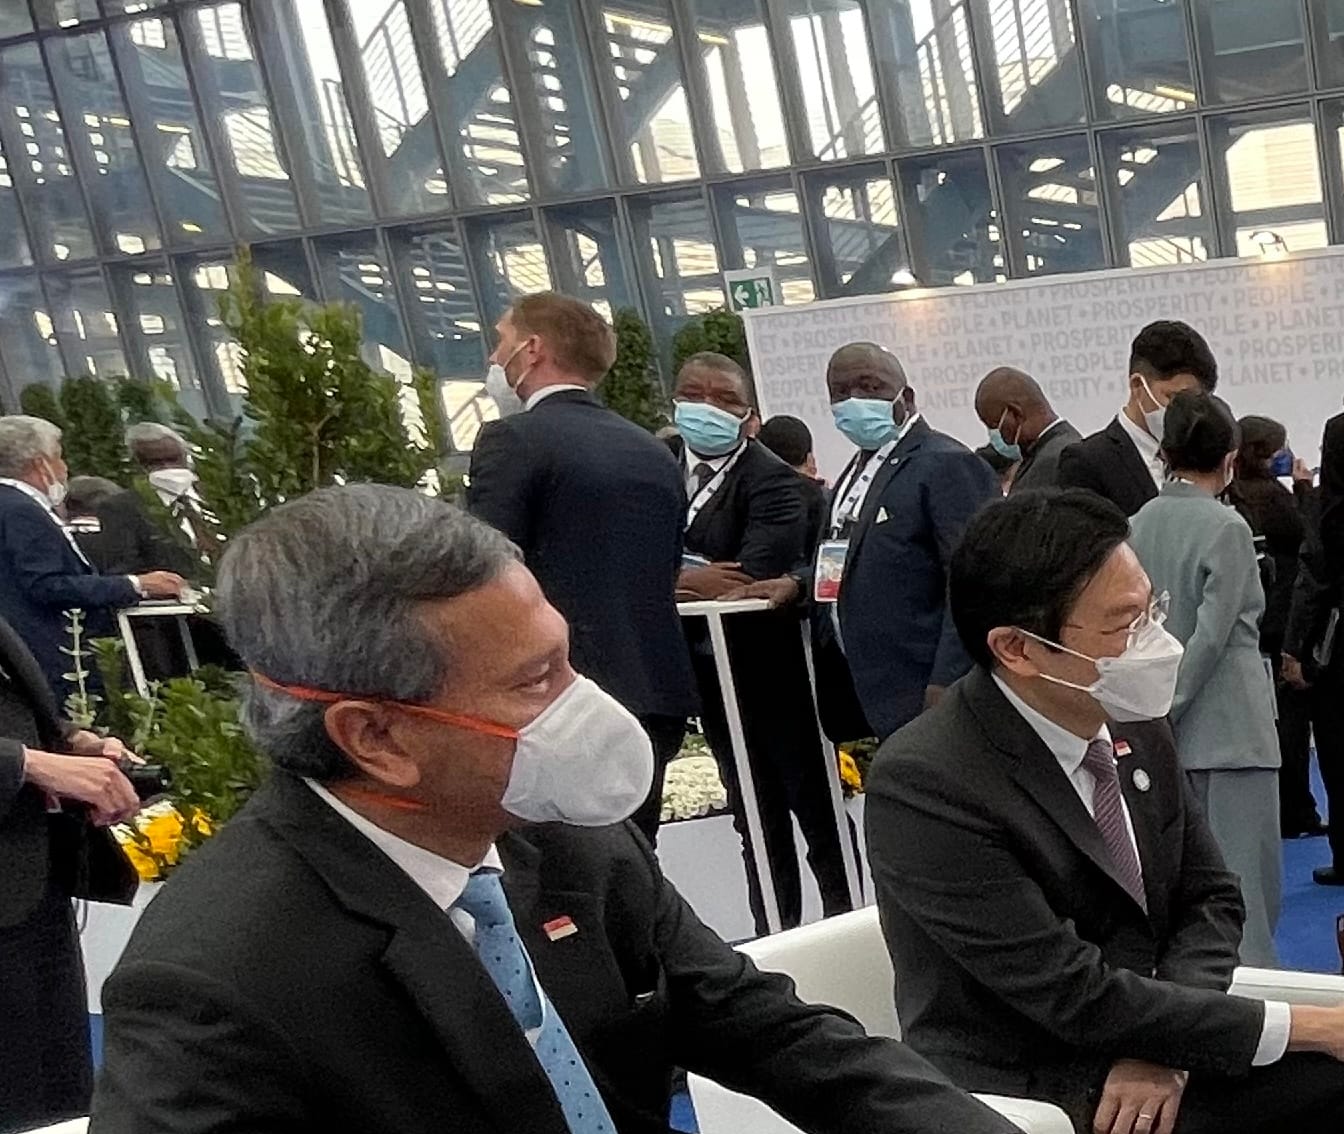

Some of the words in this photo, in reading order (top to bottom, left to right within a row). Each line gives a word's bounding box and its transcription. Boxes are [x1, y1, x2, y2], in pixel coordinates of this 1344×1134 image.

[915, 313, 985, 338] PEOPLE
[1001, 304, 1073, 330] PLANET
[1092, 290, 1215, 321] PROSPERITY
[1233, 281, 1315, 309] PEOPLE
[943, 335, 1013, 360] PLANET
[1031, 323, 1136, 351] PROSPERIT
[1051, 350, 1124, 374] PEOPLE
